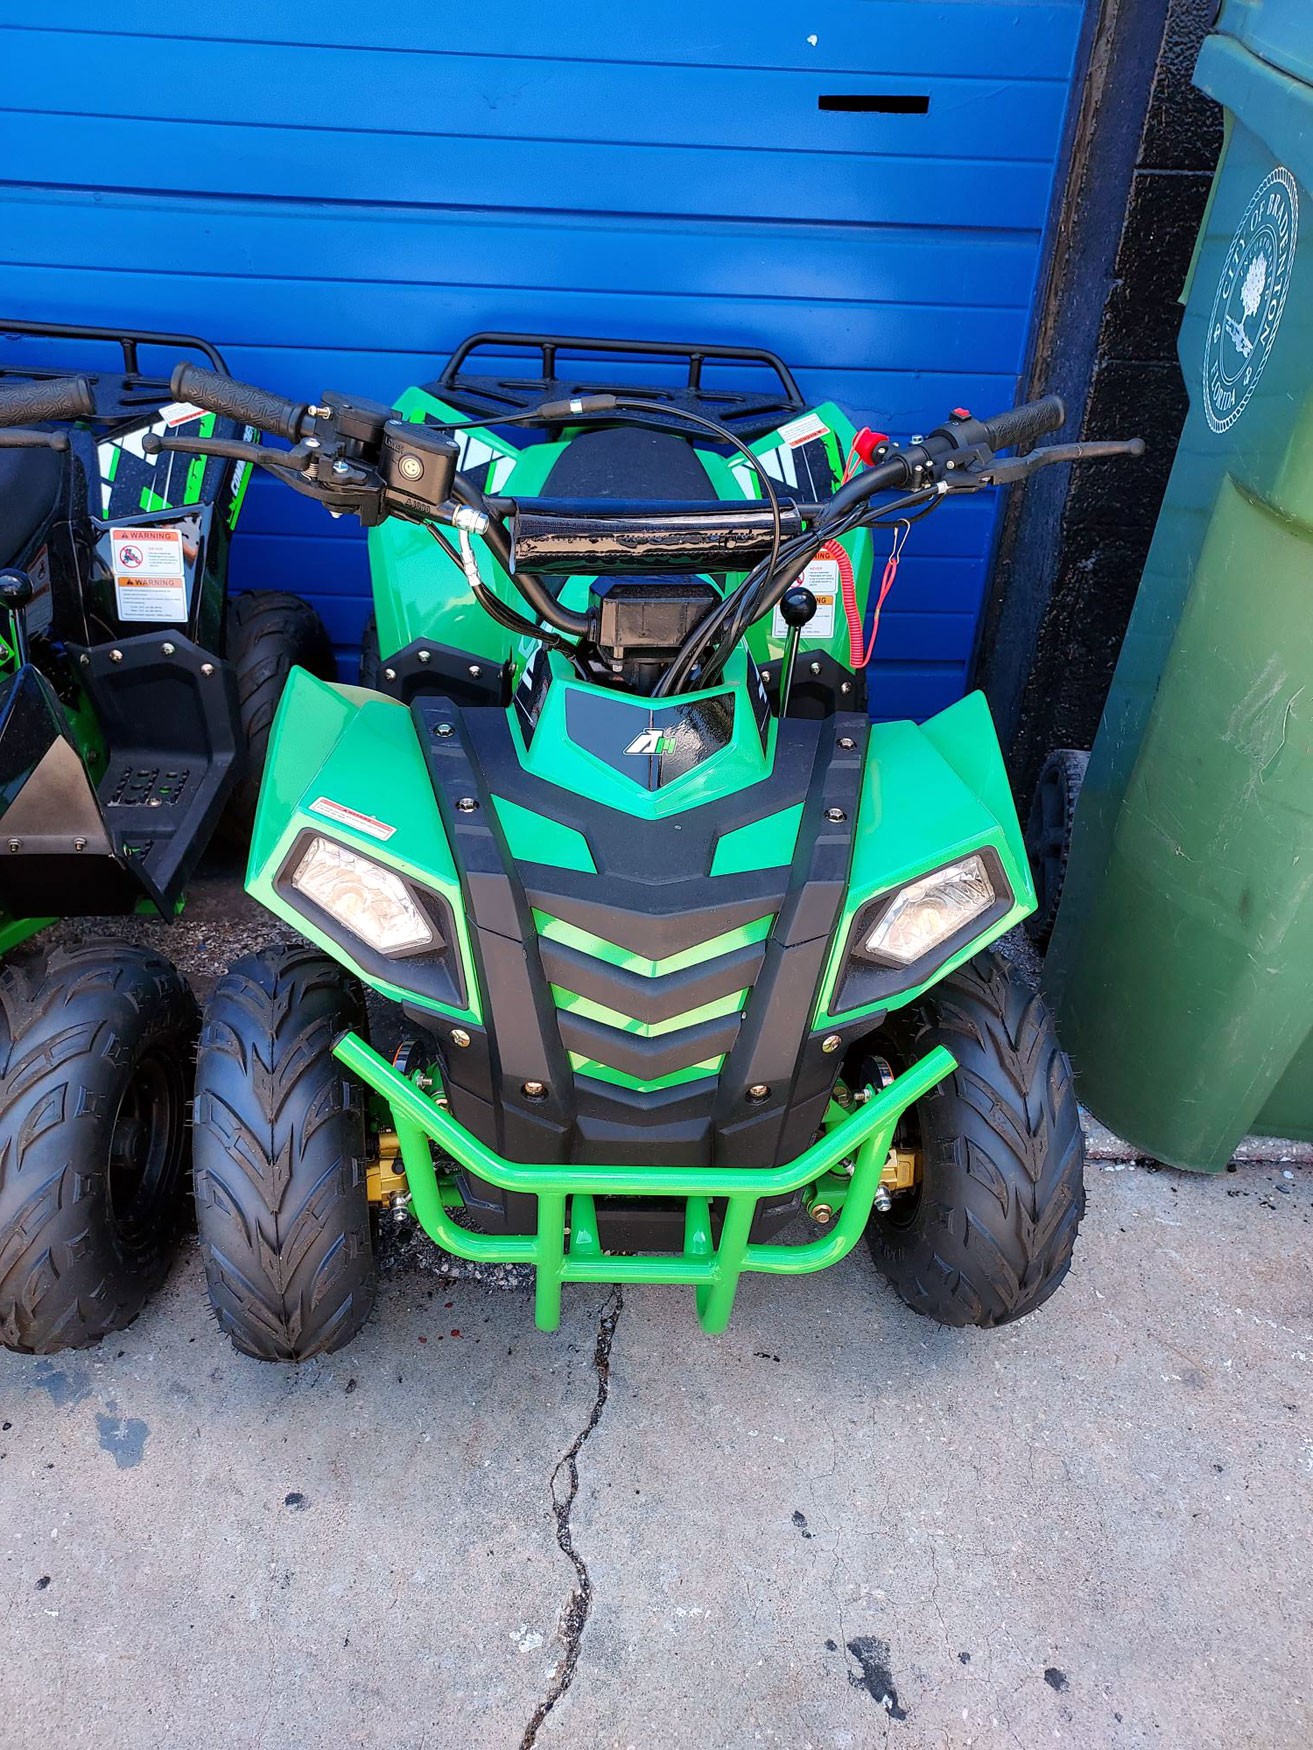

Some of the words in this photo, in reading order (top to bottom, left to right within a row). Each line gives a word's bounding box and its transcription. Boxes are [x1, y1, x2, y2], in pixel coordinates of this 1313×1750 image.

[1222, 230, 1246, 299] CITY
[1251, 200, 1265, 231] OF
[1260, 193, 1288, 347] BRADENTON
[1211, 359, 1236, 411] FLORIDA
[130, 532, 171, 540] WARNING
[135, 579, 175, 587] WARNING
